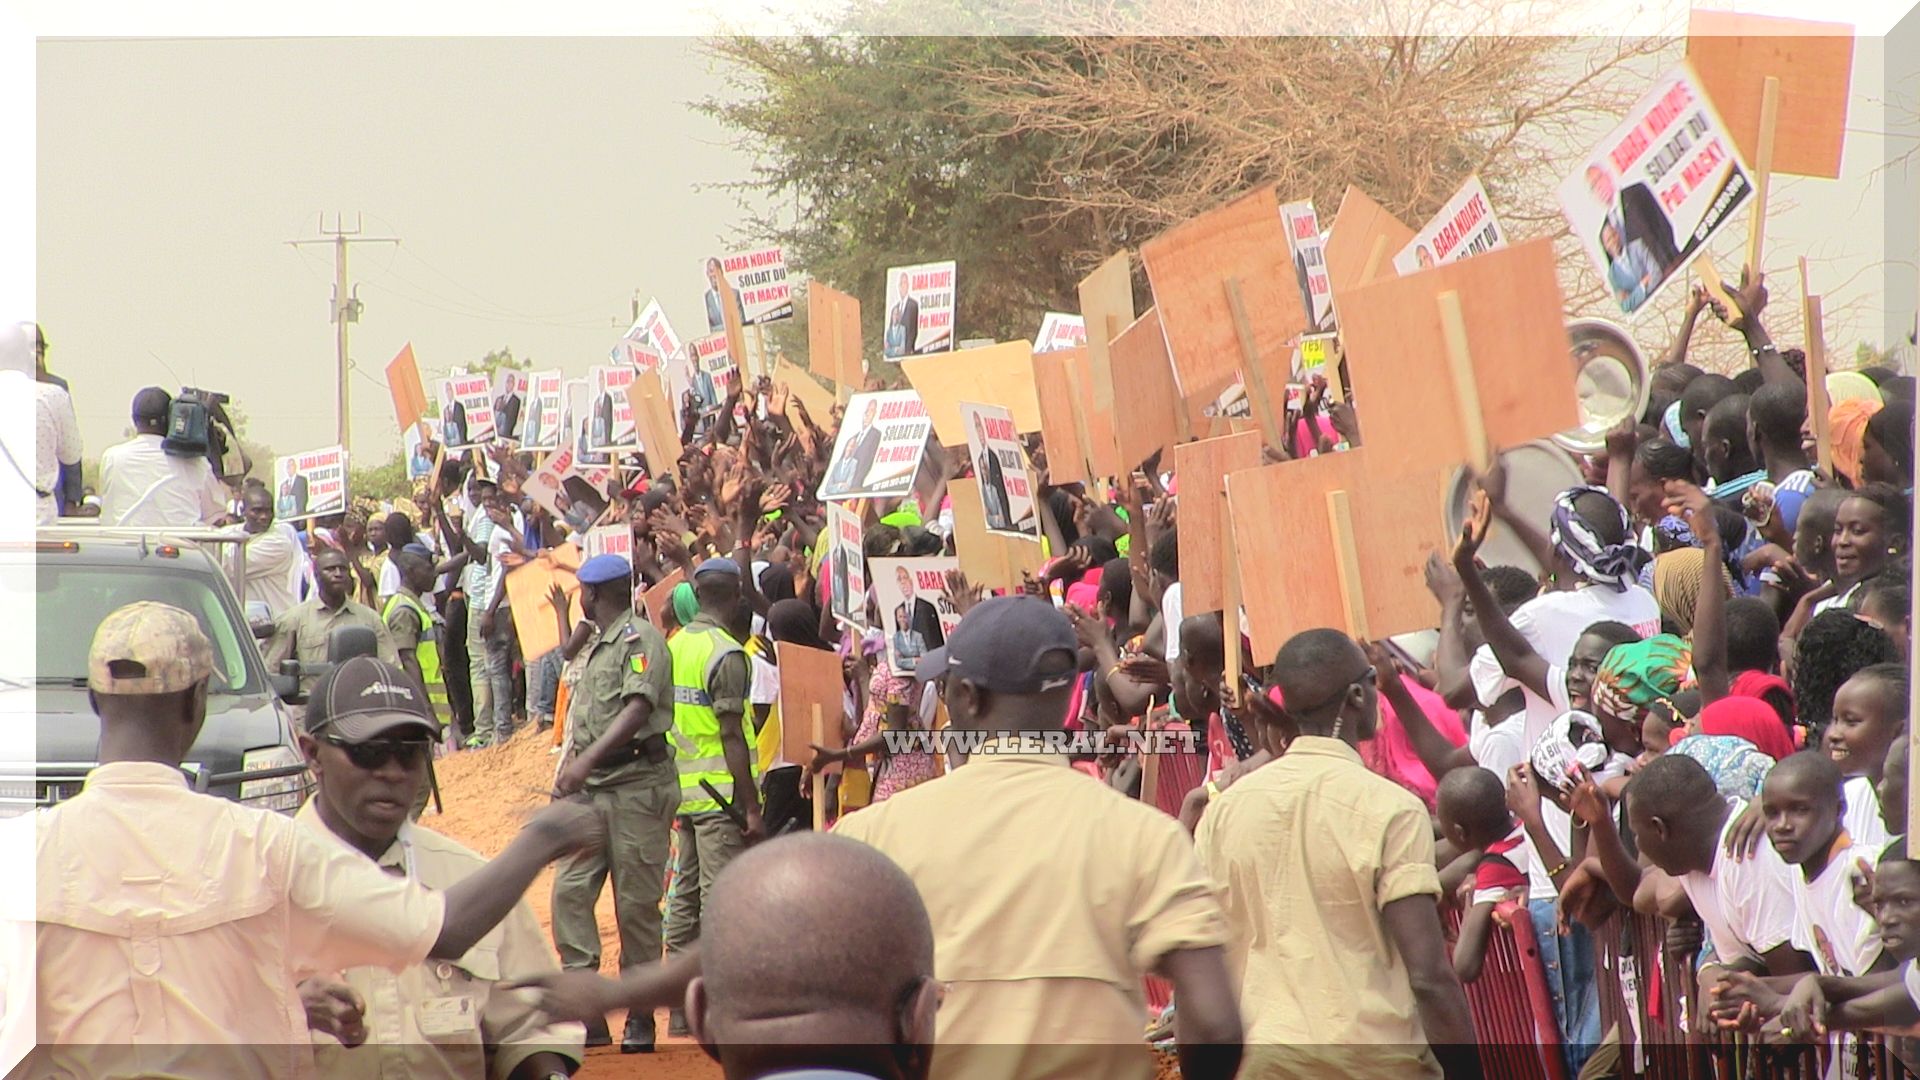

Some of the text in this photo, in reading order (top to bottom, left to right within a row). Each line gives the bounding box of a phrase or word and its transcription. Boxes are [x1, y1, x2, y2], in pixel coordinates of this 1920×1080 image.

[1433, 192, 1487, 260] BARA NDIAYE
[1483, 221, 1498, 249] DU
[724, 250, 783, 272] BARA NDIAYE
[738, 268, 786, 288] SOLDAT DU
[757, 285, 790, 303] MACKY
[883, 423, 926, 441] SOLDAT DU
[916, 571, 945, 590] BARA
[937, 597, 958, 615] SOL
